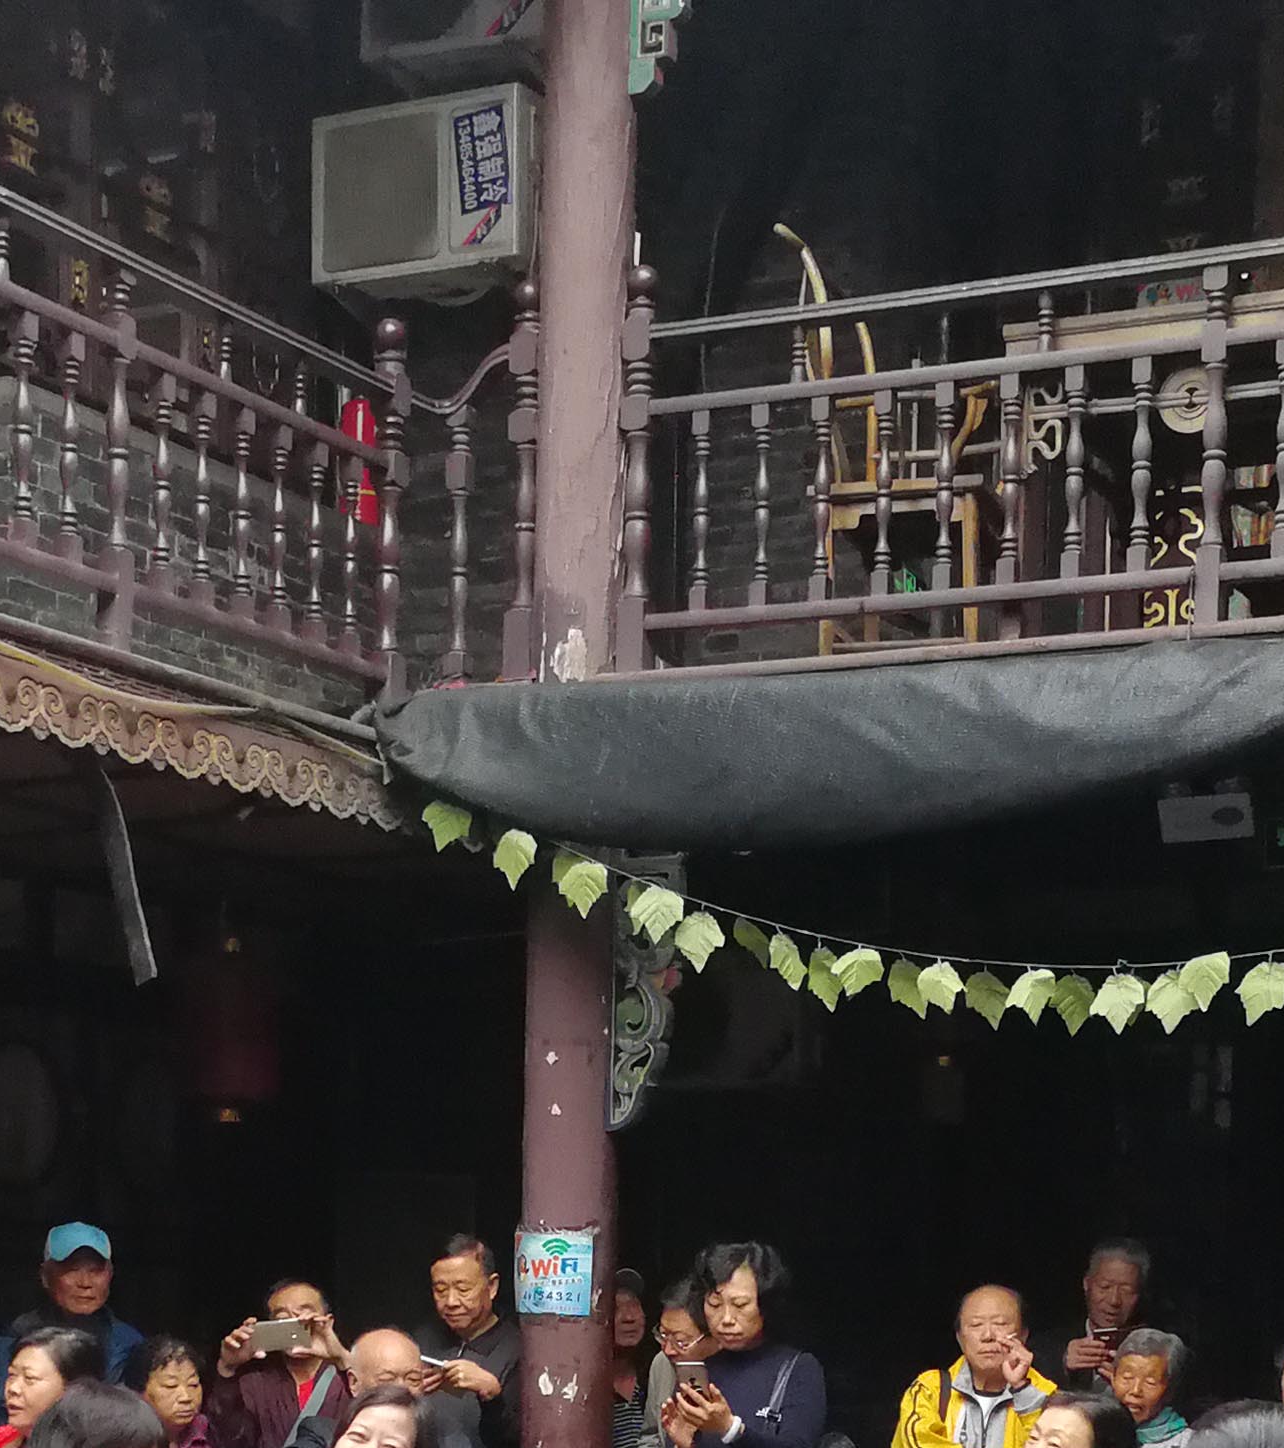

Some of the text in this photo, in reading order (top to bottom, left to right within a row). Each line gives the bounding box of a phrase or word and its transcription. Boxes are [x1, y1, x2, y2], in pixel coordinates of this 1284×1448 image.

[472, 110, 507, 203] 鑫强制冷
[530, 1255, 579, 1279] WiFi
